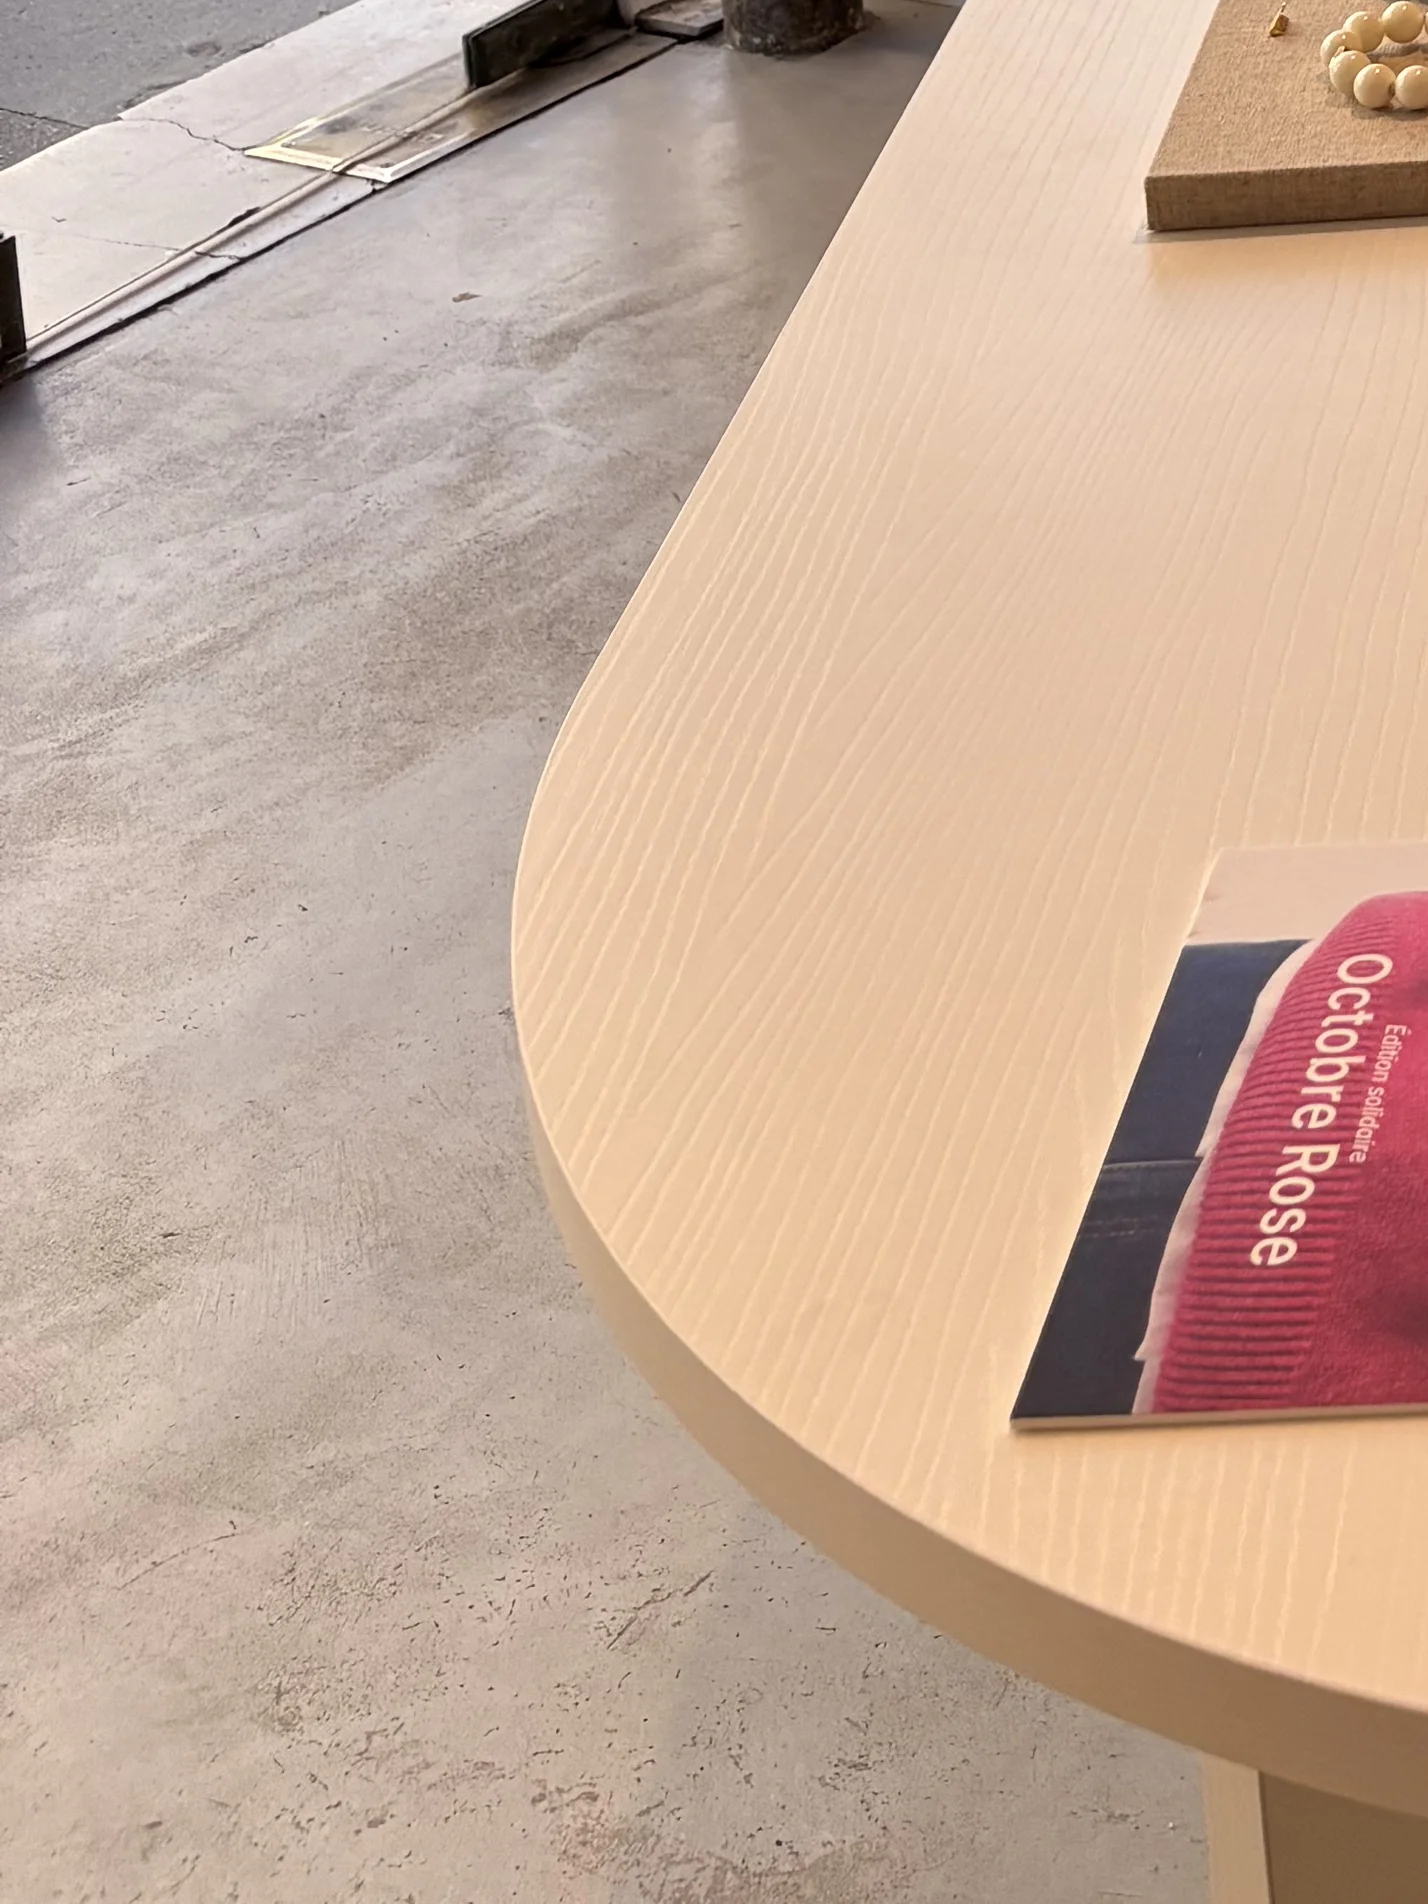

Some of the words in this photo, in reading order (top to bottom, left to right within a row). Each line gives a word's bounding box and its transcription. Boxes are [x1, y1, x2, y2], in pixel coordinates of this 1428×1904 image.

[1291, 953, 1393, 1130] Octobre
[1372, 1024, 1412, 1084] Édition
[1349, 1085, 1385, 1165] solidaire
[1250, 1143, 1341, 1267] Rose
